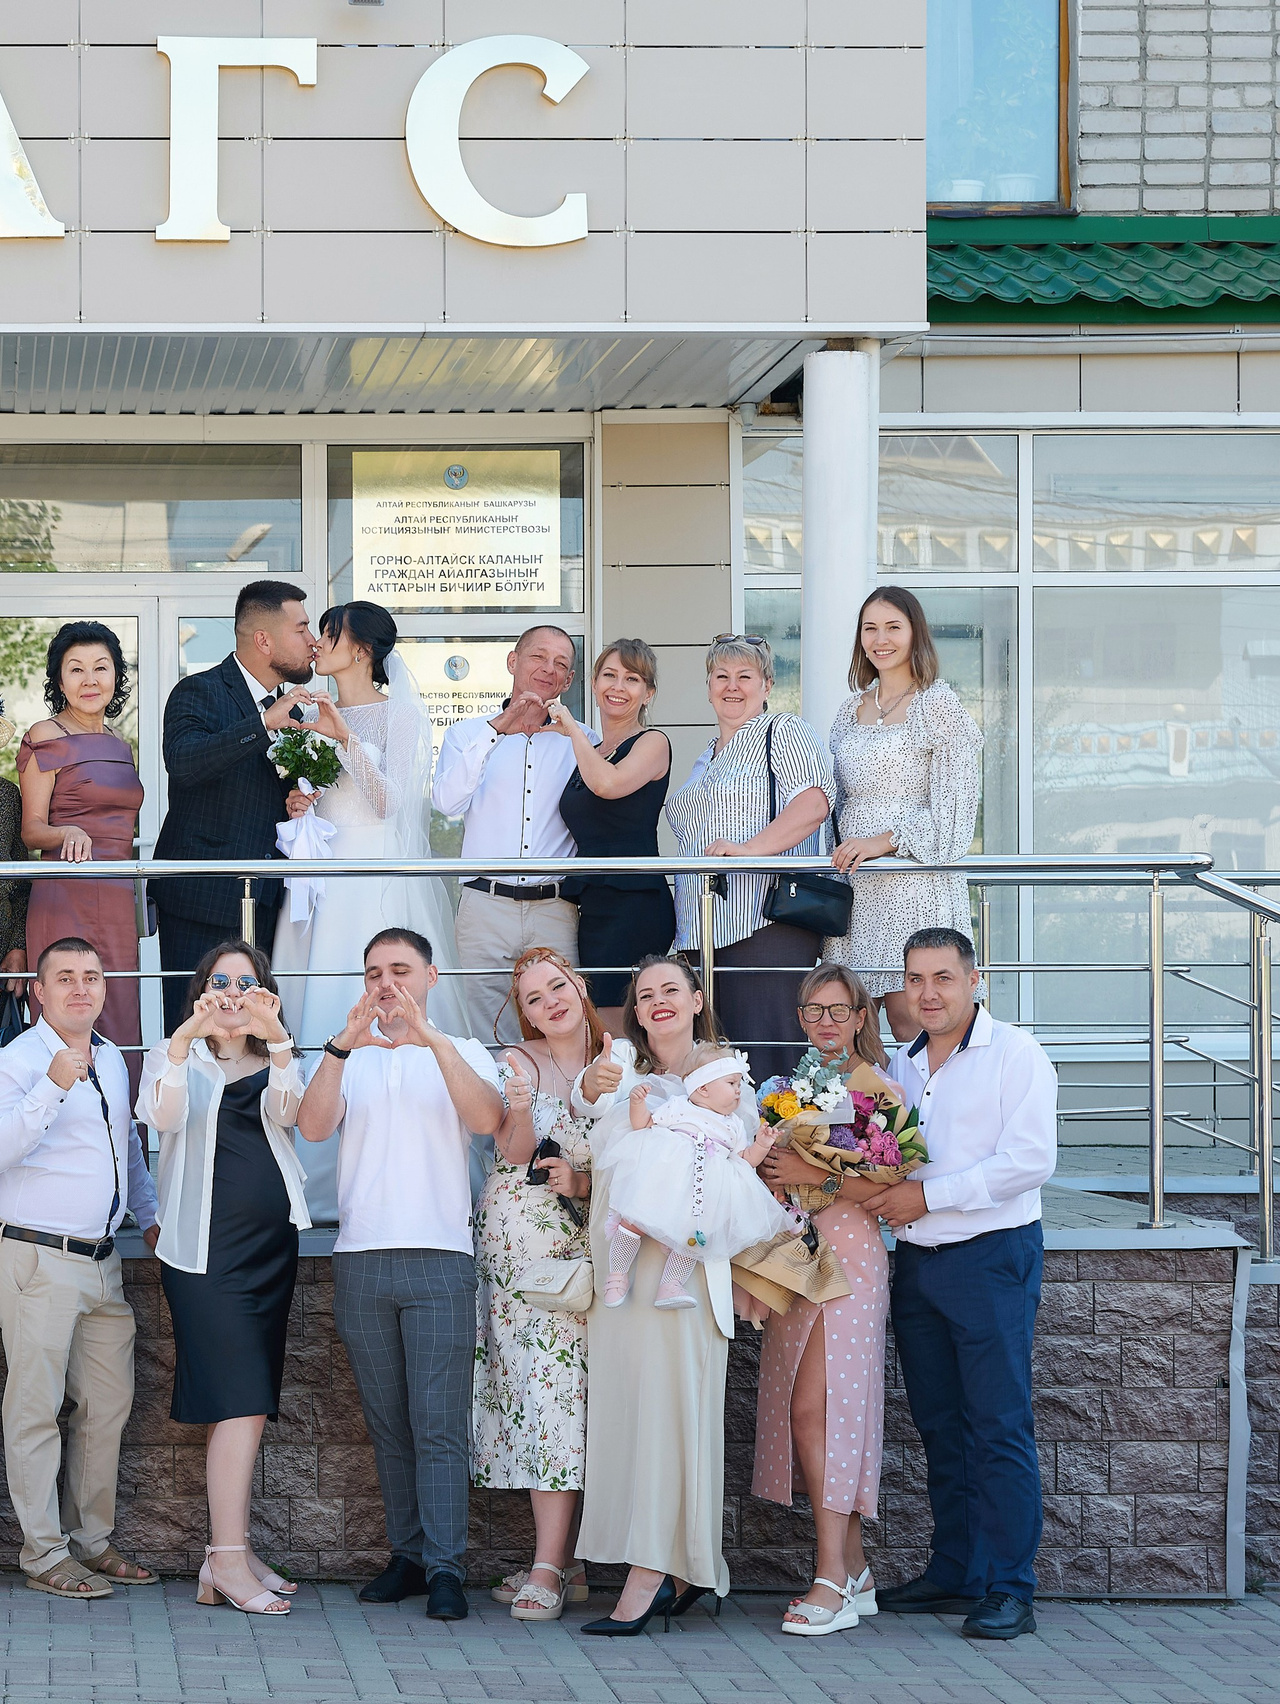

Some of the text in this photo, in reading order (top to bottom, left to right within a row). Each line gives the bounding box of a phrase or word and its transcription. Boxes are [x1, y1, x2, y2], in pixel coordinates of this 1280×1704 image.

[376, 500, 403, 508] АЛТАЙ
[483, 500, 536, 508] БАШКАРУЗЫ
[394, 514, 426, 524] АЛТАЙ
[455, 525, 550, 534] МИНИСТЕРСТВОЗЫ
[370, 553, 475, 565] ГОРНО-АЛТАЙСК
[374, 569, 434, 580] ГРАЖДАН
[367, 582, 436, 592] АКТТАРЫН
[440, 582, 492, 592] БИЧИИР
[451, 691, 506, 699] РЕСПУБЛИКИ
